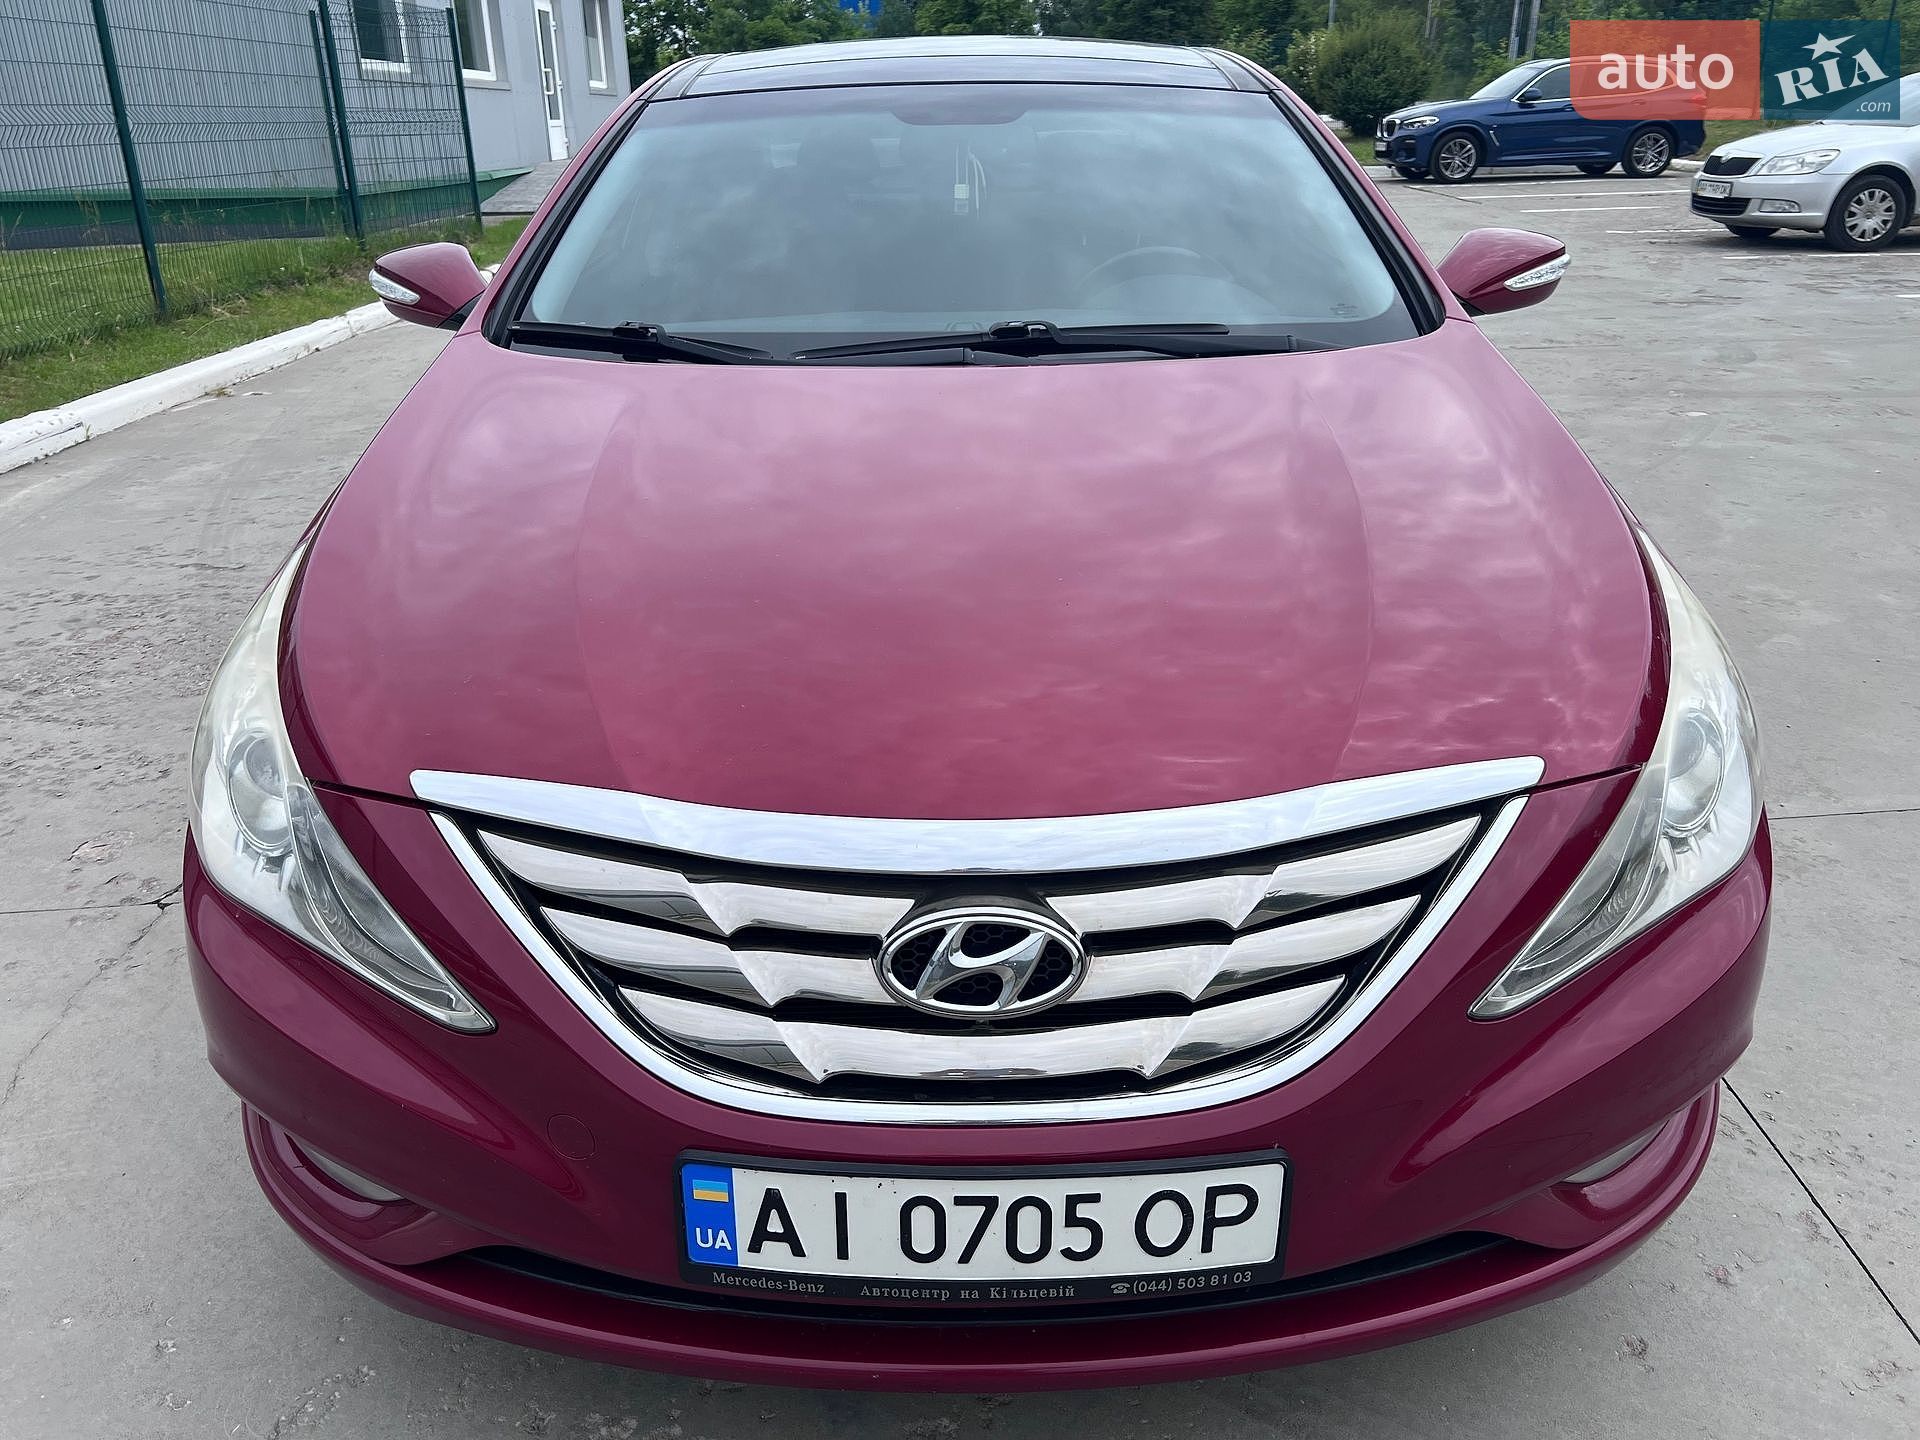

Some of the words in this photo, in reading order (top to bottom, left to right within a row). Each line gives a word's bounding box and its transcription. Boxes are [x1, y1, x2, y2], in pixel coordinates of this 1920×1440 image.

[747, 1187, 849, 1260] AI
[899, 1192, 1104, 1264] 0705
[1134, 1183, 1259, 1258] OP
[695, 1227, 732, 1250] UA
[712, 1271, 825, 1293] Mercedes-Benz
[860, 1285, 950, 1300] Автоцентр
[960, 1289, 980, 1299] на
[1133, 1278, 1172, 1294] (044)
[1177, 1276, 1205, 1290] 503
[1210, 1274, 1228, 1286] 81
[1233, 1270, 1252, 1284] 03
